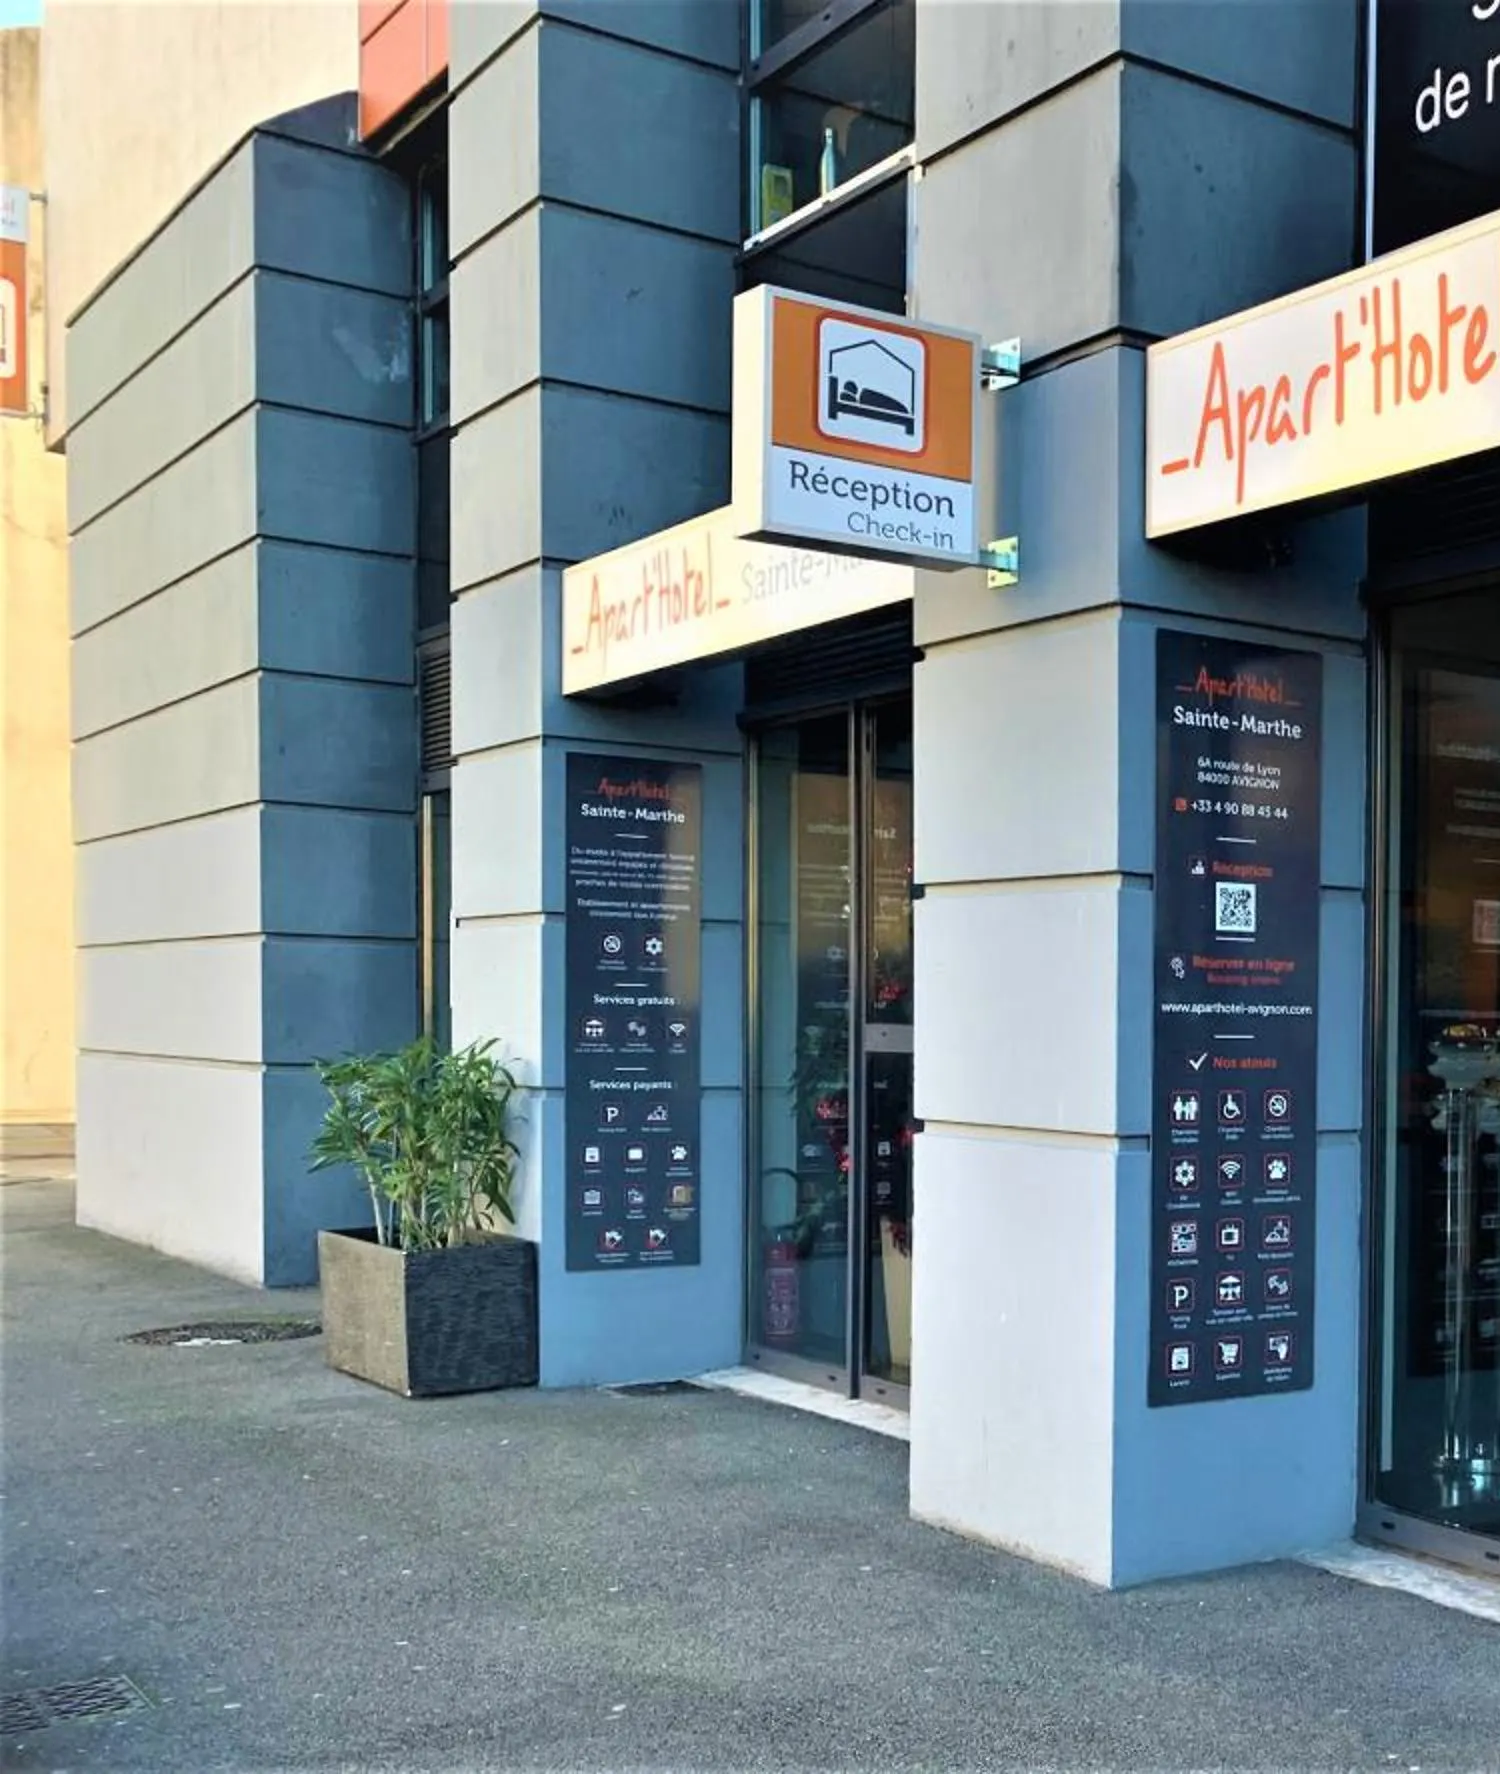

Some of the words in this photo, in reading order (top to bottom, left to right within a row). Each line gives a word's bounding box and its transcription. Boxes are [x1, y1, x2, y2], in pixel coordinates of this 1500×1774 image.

[1415, 67, 1472, 133] de
[789, 460, 955, 518] Réception
[847, 511, 954, 549] Check-in
[1242, 762, 1255, 773] de
[1257, 762, 1281, 776] Lyon
